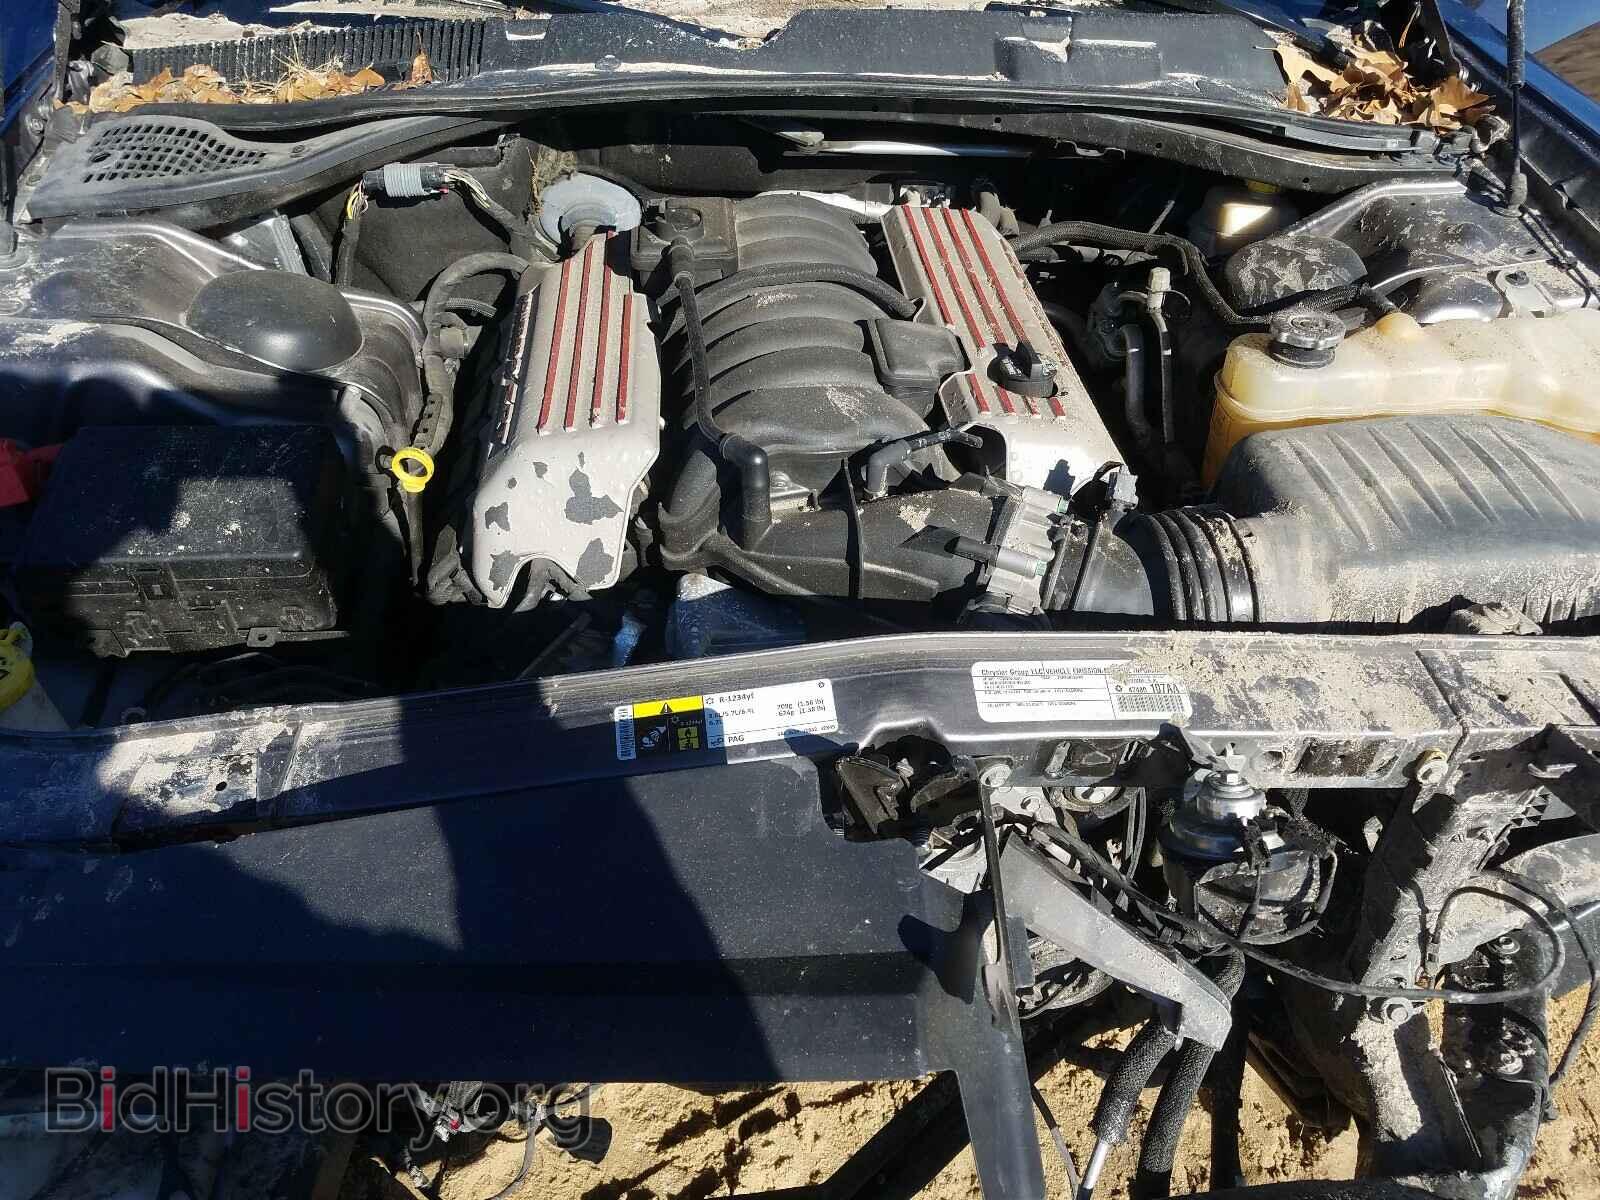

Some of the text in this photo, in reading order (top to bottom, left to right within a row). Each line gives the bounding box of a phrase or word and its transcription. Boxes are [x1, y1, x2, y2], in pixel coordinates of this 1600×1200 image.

[981, 669, 1008, 677] Chrysler
[1009, 668, 1030, 677] Group
[728, 735, 745, 743] PAG
